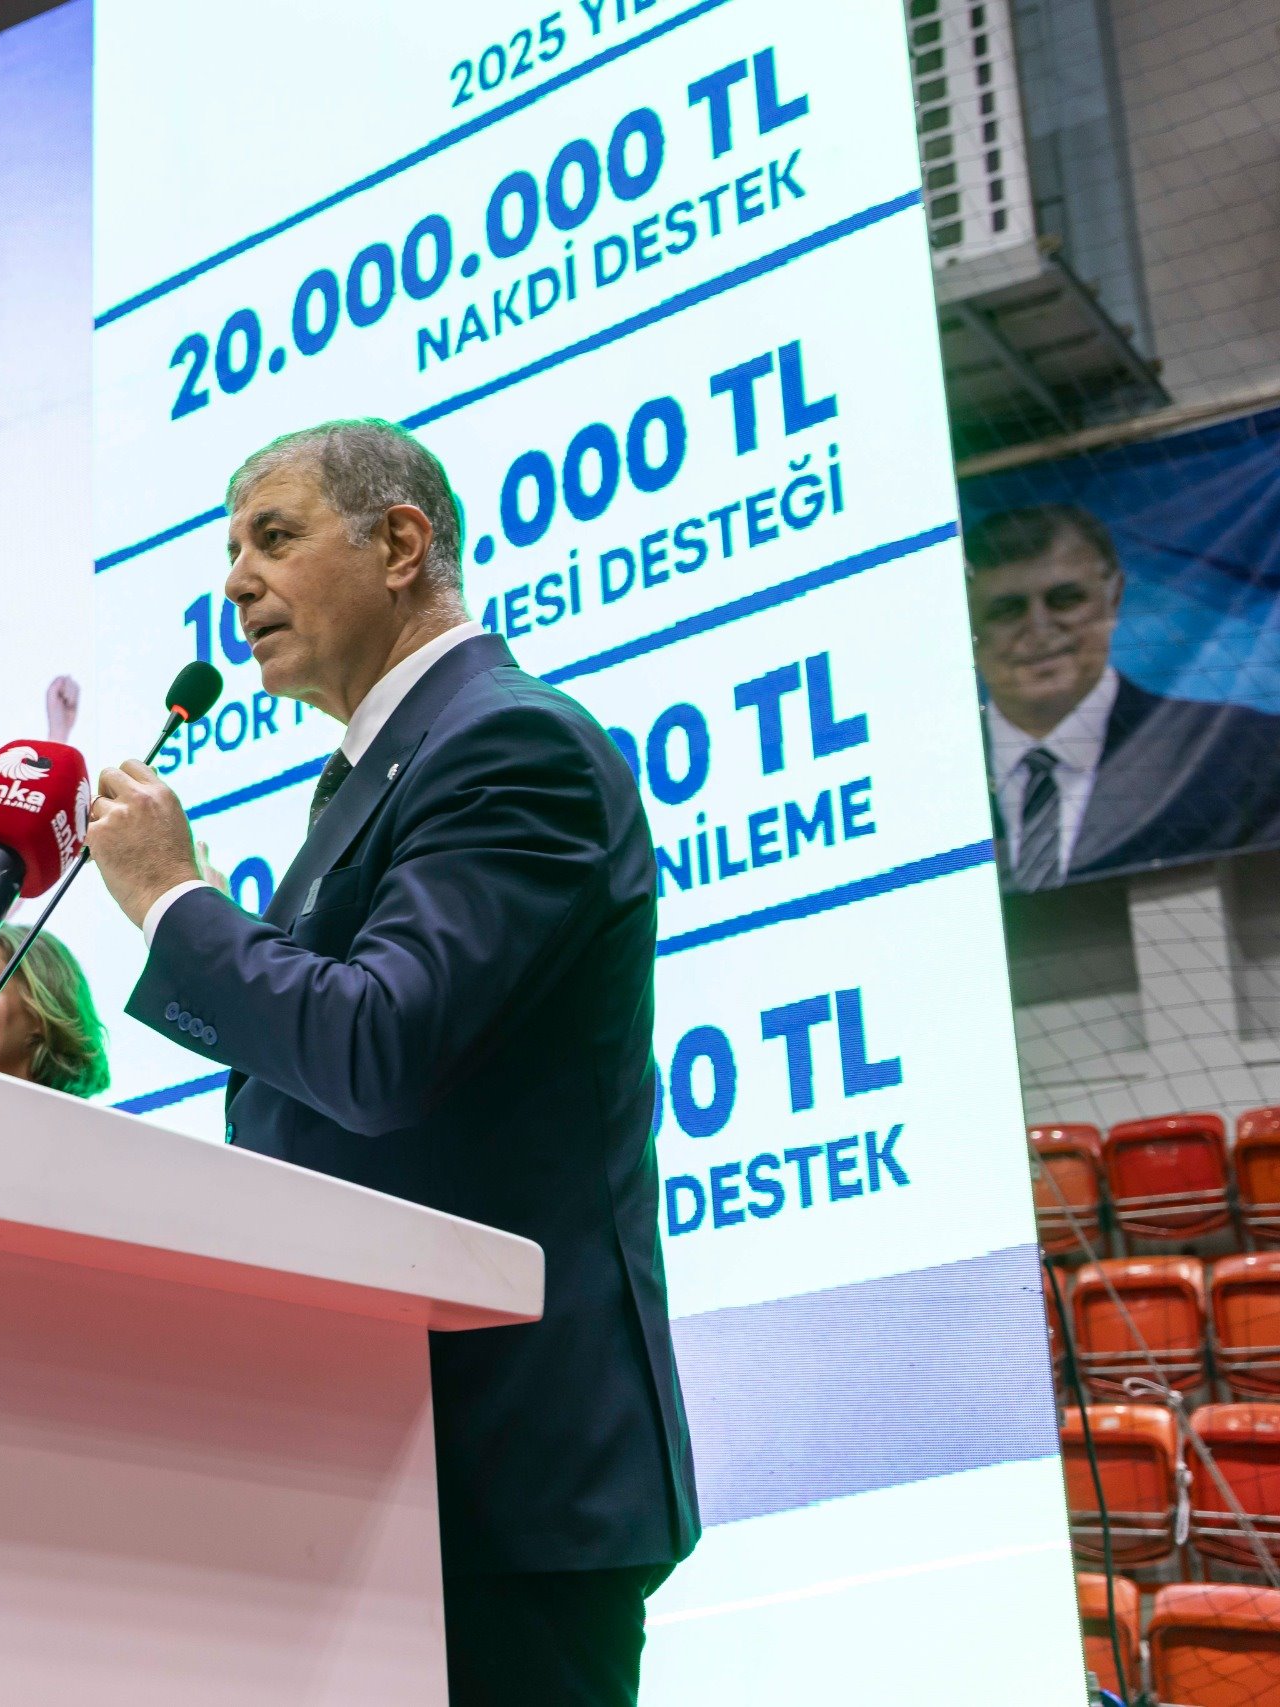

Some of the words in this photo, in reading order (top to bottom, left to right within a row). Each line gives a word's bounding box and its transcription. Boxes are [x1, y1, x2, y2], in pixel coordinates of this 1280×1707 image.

[450, 11, 566, 108] 2025
[170, 106, 665, 420] 20.000.000
[688, 46, 809, 160] TL
[417, 240, 577, 371] NAKDİ
[595, 149, 806, 289] DESTEK
[710, 340, 838, 456] TL
[600, 444, 846, 604] DESTEĞİ
[733, 650, 870, 776] TL
[654, 775, 877, 897] NİLEME
[760, 985, 904, 1114] TL
[664, 1123, 911, 1237] DESTEK
